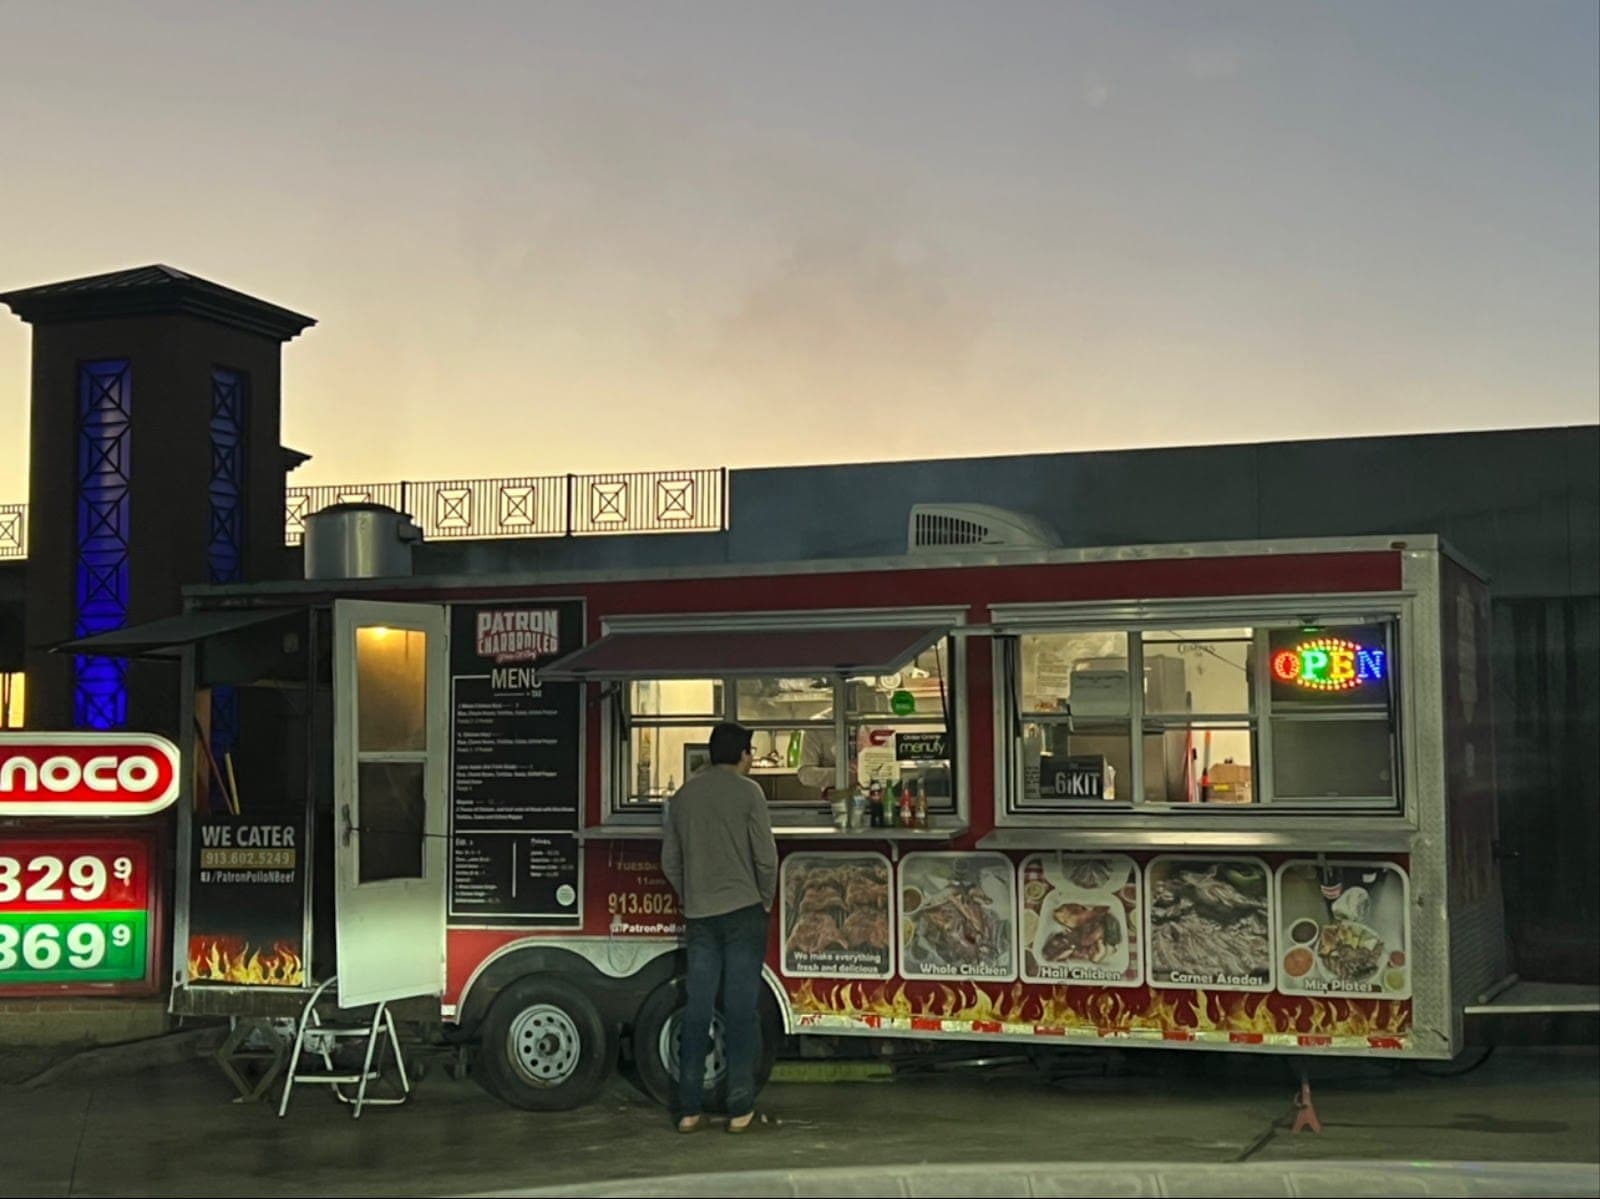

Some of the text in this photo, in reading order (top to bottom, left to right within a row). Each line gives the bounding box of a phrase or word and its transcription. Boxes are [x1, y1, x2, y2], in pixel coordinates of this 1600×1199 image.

[477, 610, 559, 640] PATRON
[1273, 650, 1385, 681] OPEN
[491, 668, 542, 689] MENU
[202, 826, 295, 847] WE CATER
[206, 852, 290, 865] 913.602.5249
[112, 924, 131, 947] 9
[835, 953, 881, 964] everything
[821, 964, 837, 972] and
[920, 962, 1007, 976] Whole Chicken
[1071, 968, 1121, 980] Chicken
[1170, 971, 1262, 985] Carnes Asadas
[1305, 980, 1373, 992] Mix Plates
